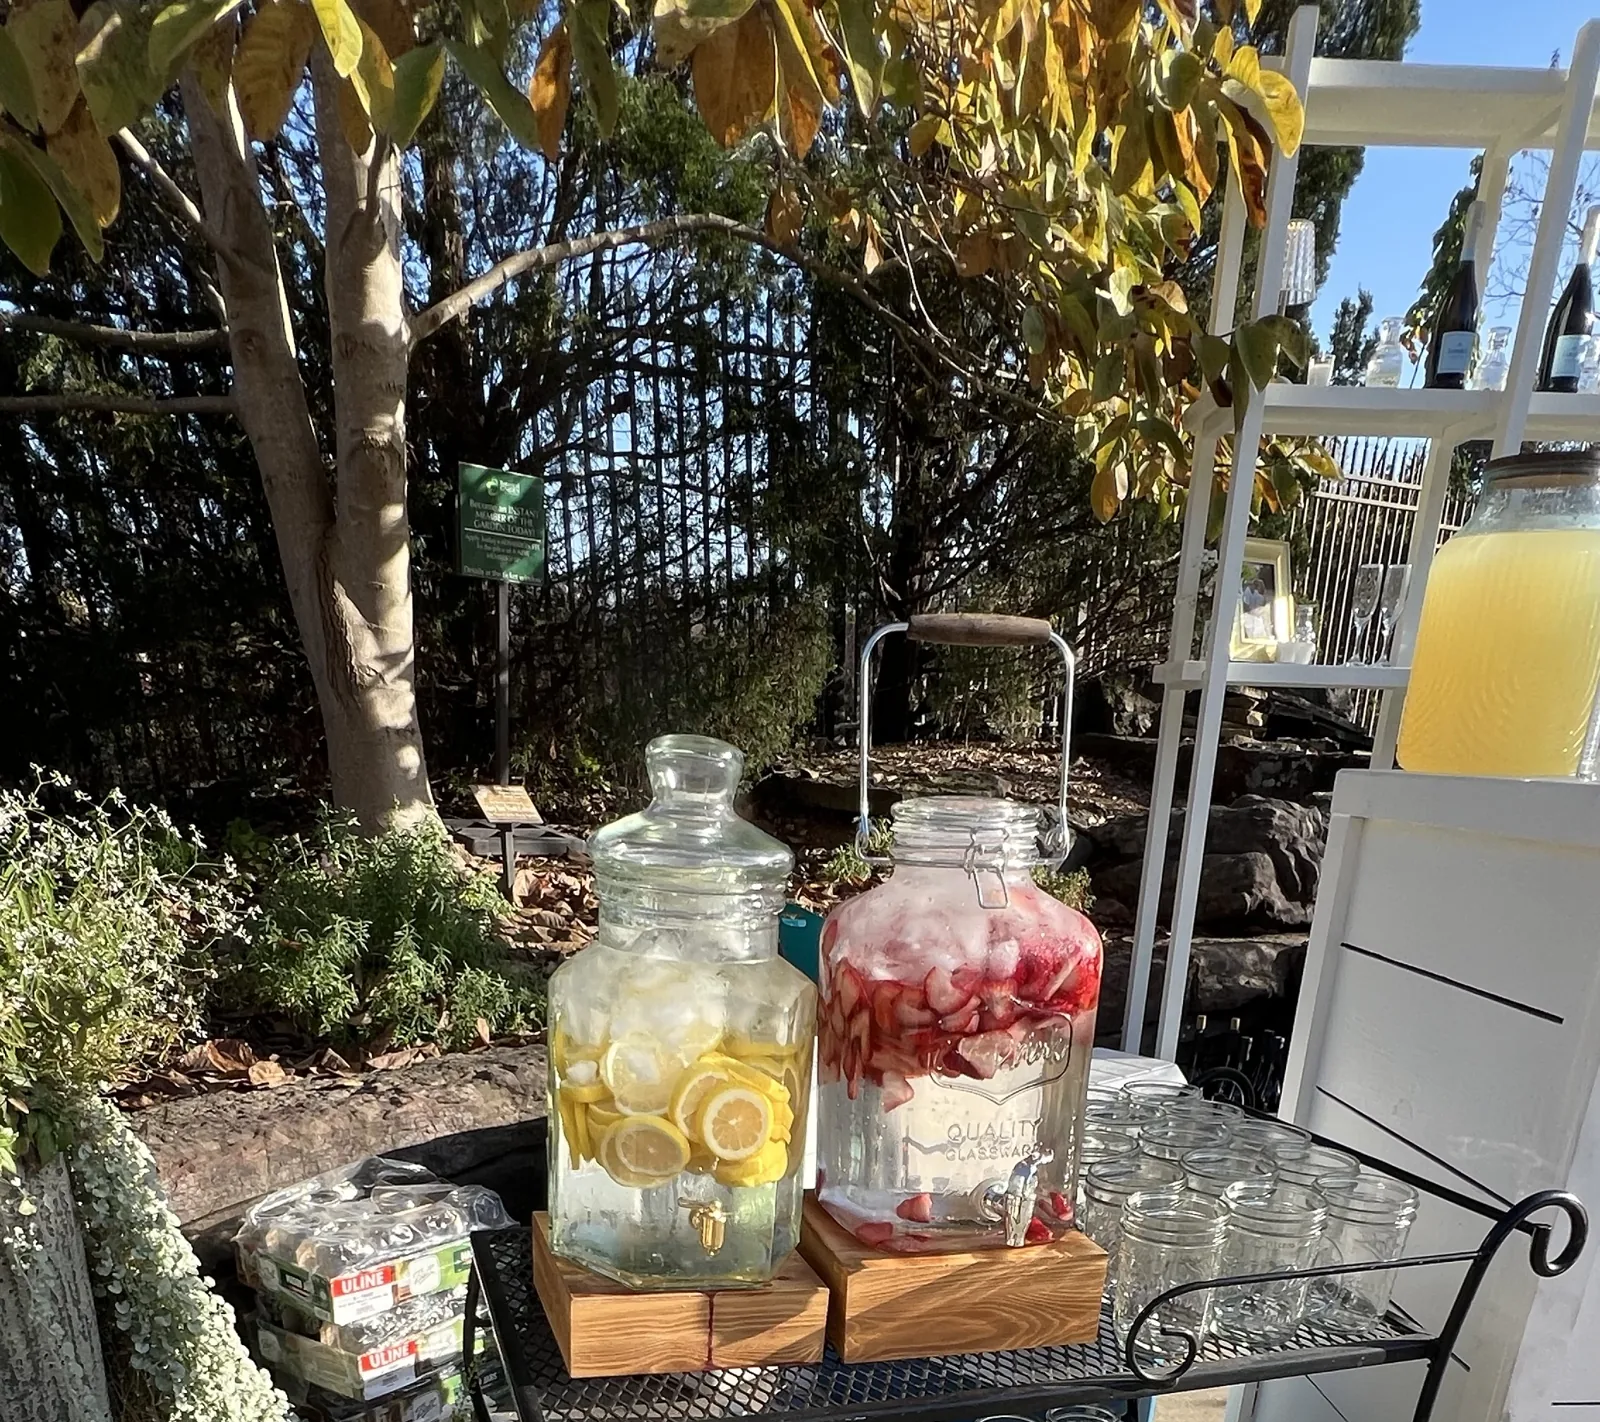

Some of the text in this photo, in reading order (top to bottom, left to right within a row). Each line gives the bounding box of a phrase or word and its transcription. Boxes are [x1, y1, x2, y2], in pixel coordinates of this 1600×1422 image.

[474, 520, 505, 532] GARDEN
[475, 510, 506, 523] MEMBER
[946, 1118, 1042, 1142] QUALITY
[341, 1271, 384, 1293] ULINE
[369, 1344, 409, 1368] ULINE
